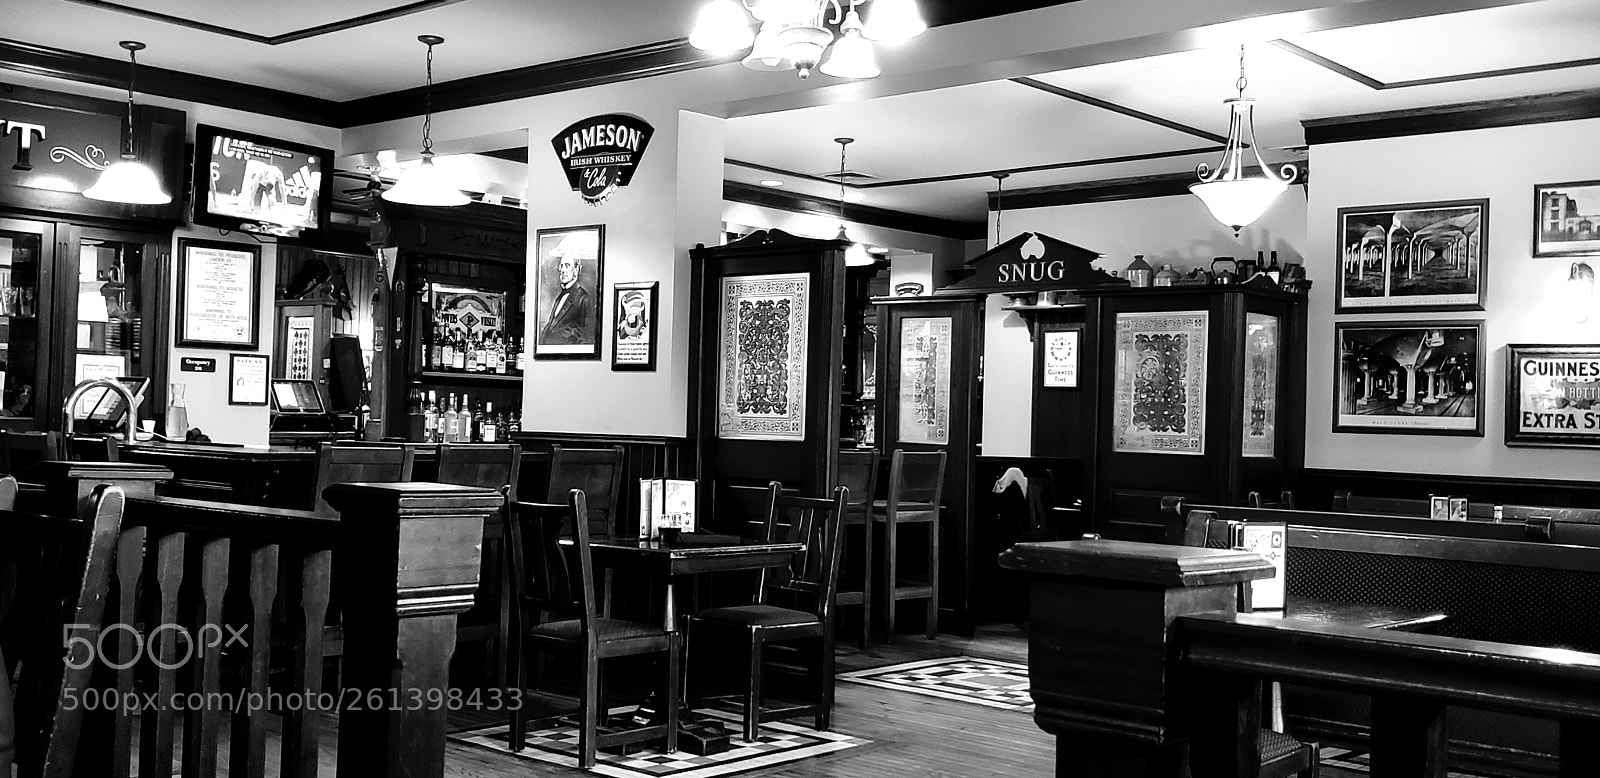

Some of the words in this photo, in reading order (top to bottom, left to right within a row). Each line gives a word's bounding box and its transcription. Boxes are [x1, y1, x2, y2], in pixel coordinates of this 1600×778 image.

[0, 119, 46, 171] T
[561, 123, 642, 159] JAMESON
[570, 157, 593, 167] IRISH
[594, 154, 632, 164] WHISKEY
[583, 167, 591, 178] &
[587, 166, 607, 189] Cola
[998, 260, 1065, 283] SNUG
[1523, 360, 1600, 377] GUINNES
[1522, 411, 1577, 429] EXTRA
